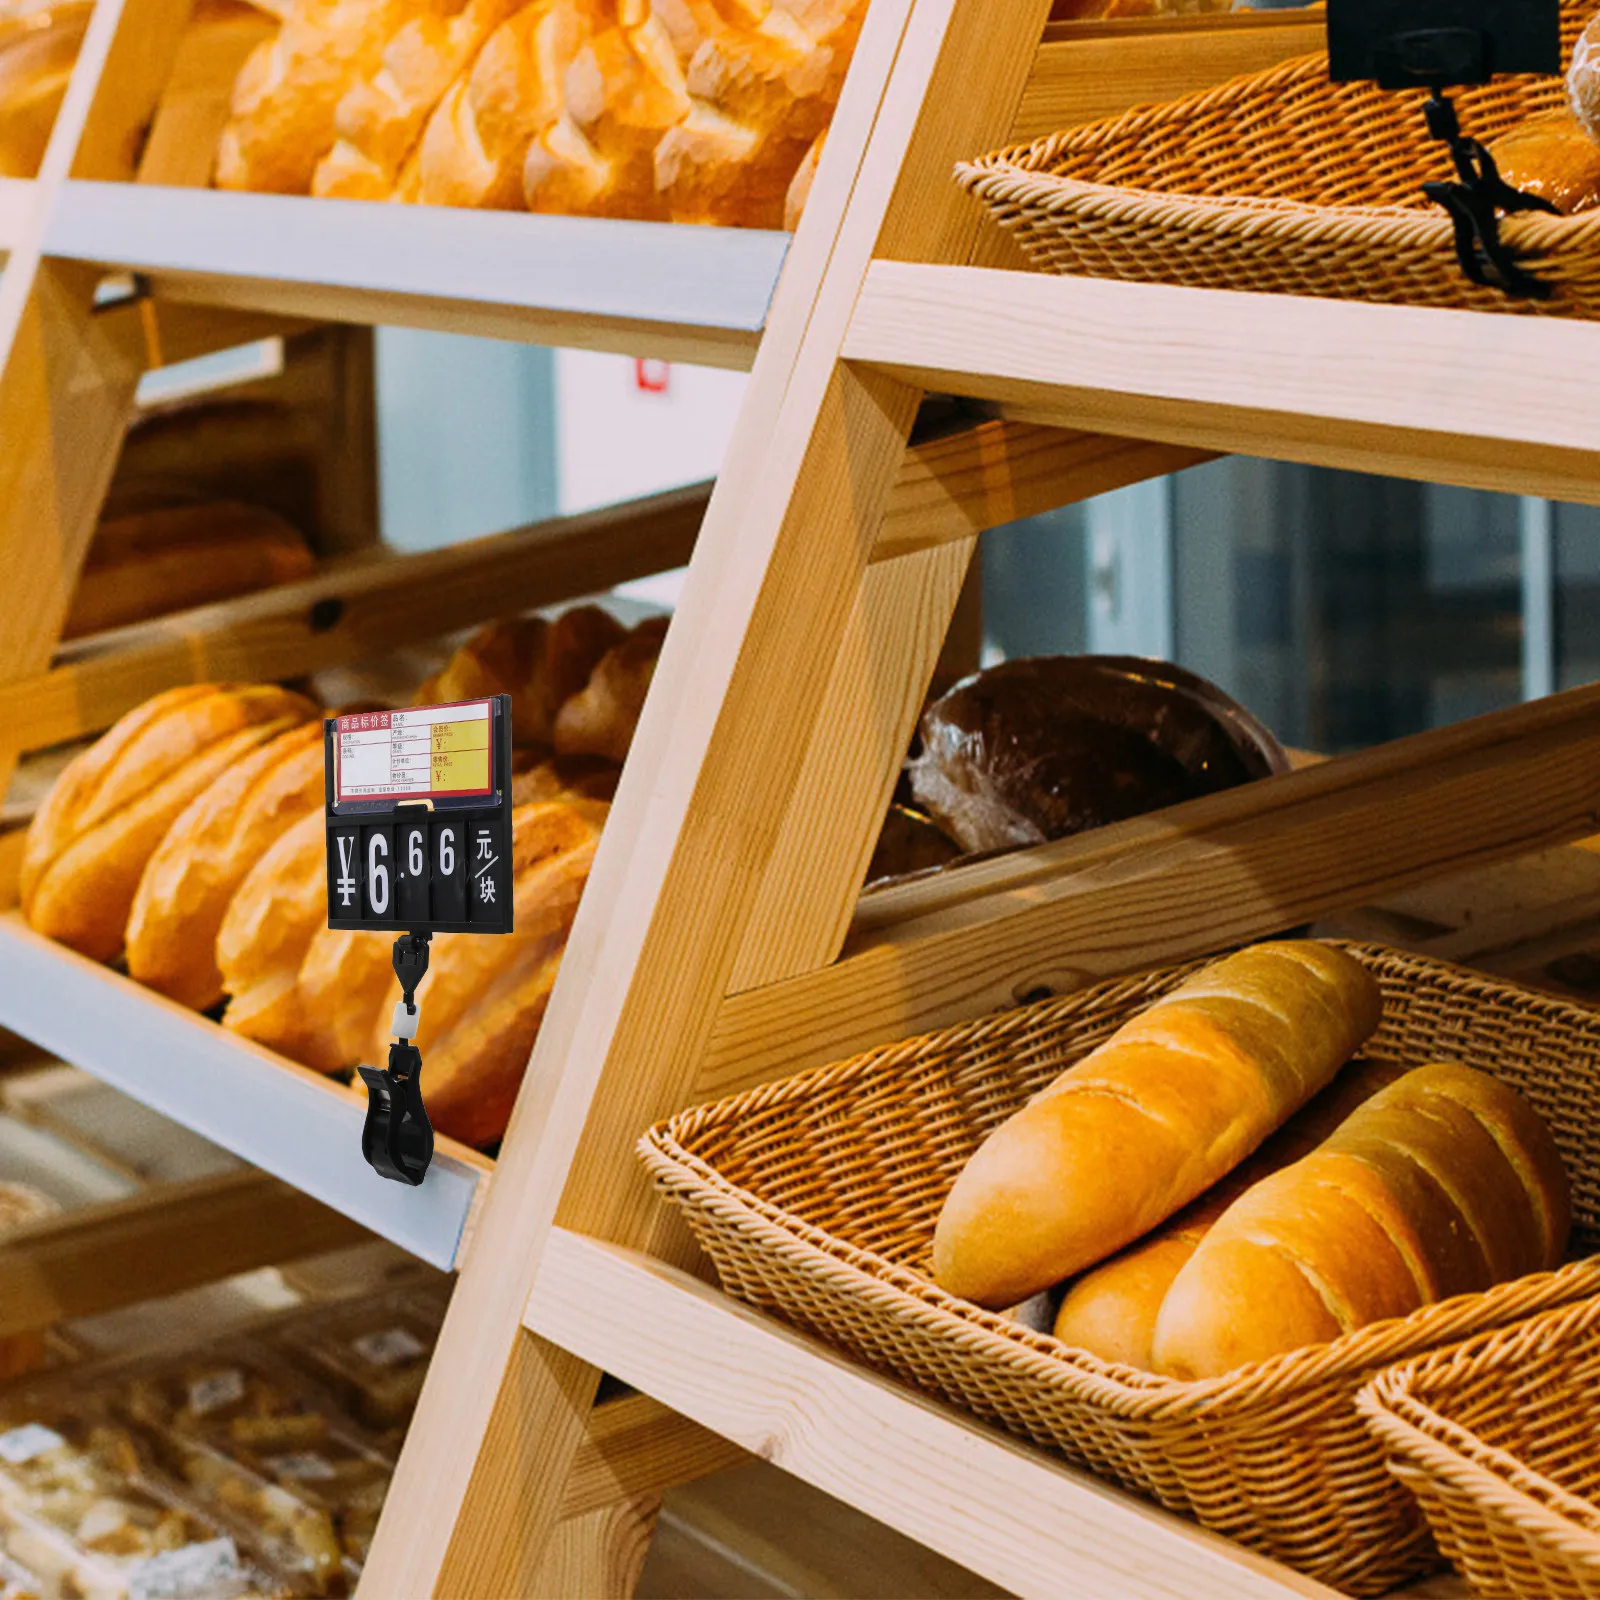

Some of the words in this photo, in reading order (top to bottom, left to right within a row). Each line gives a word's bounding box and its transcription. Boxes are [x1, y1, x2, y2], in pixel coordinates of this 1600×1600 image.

[341, 714, 389, 730] 商品标价签
